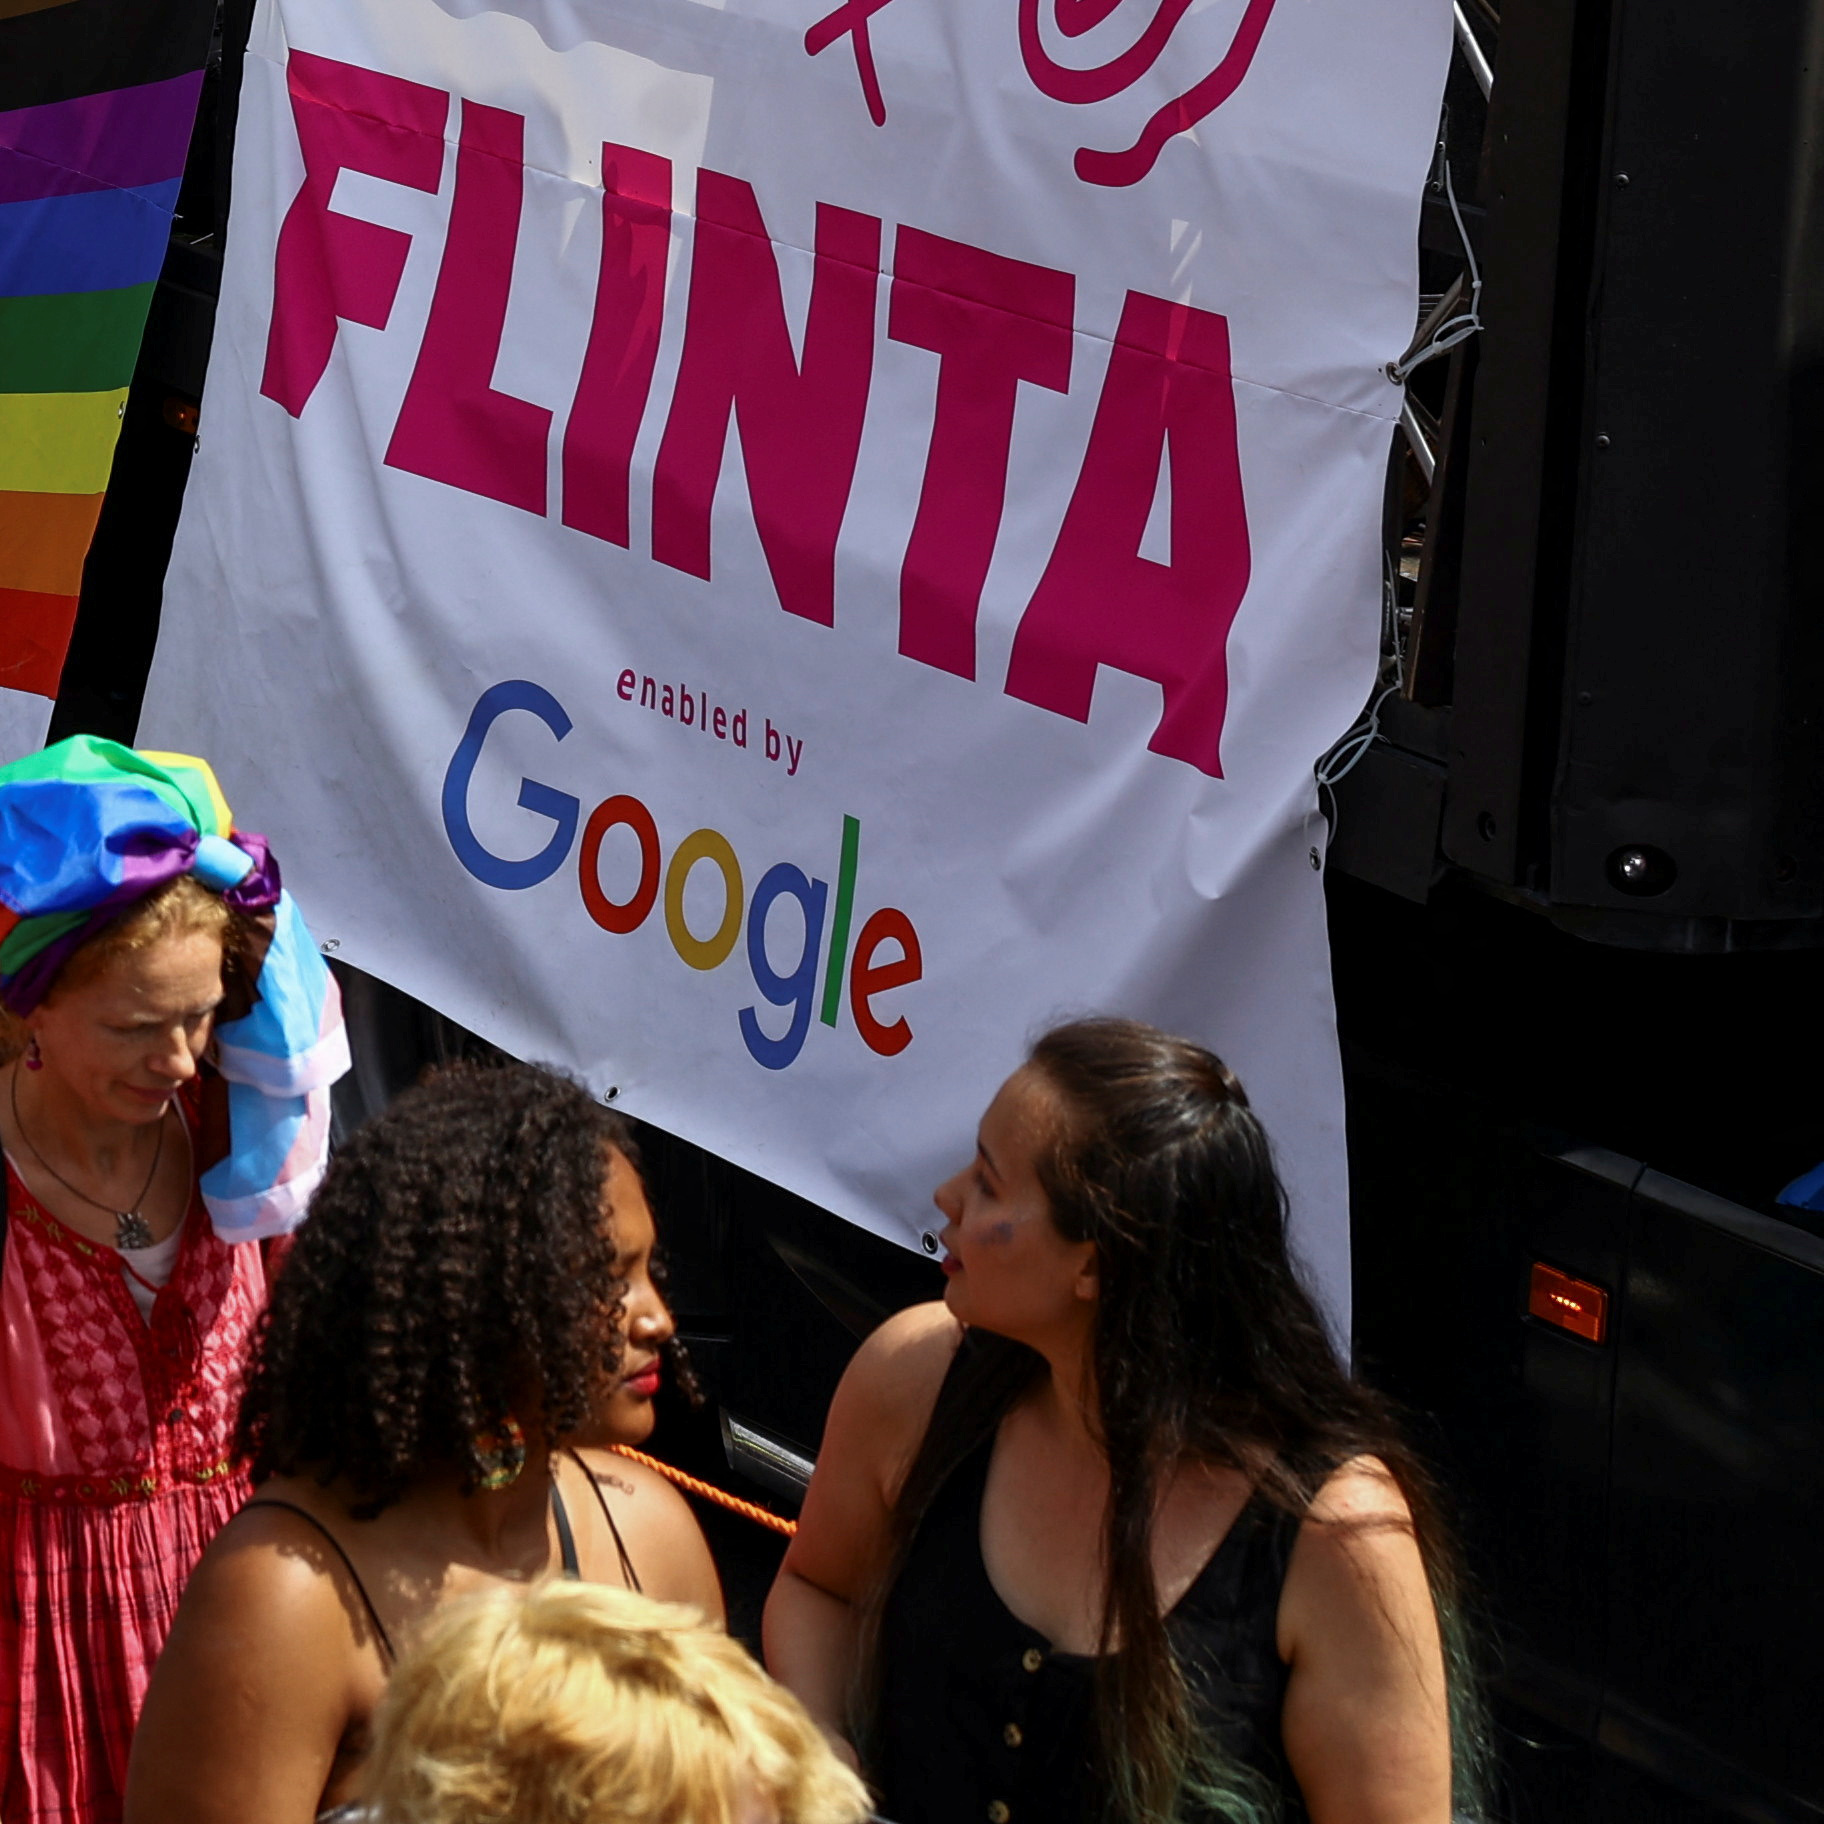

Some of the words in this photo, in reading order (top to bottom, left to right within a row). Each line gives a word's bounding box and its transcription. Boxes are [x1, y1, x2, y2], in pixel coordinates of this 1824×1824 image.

[259, 48, 1252, 781] FLINTA
[441, 678, 924, 1072] Google
[616, 668, 748, 749] enabled
[764, 718, 803, 776] by
